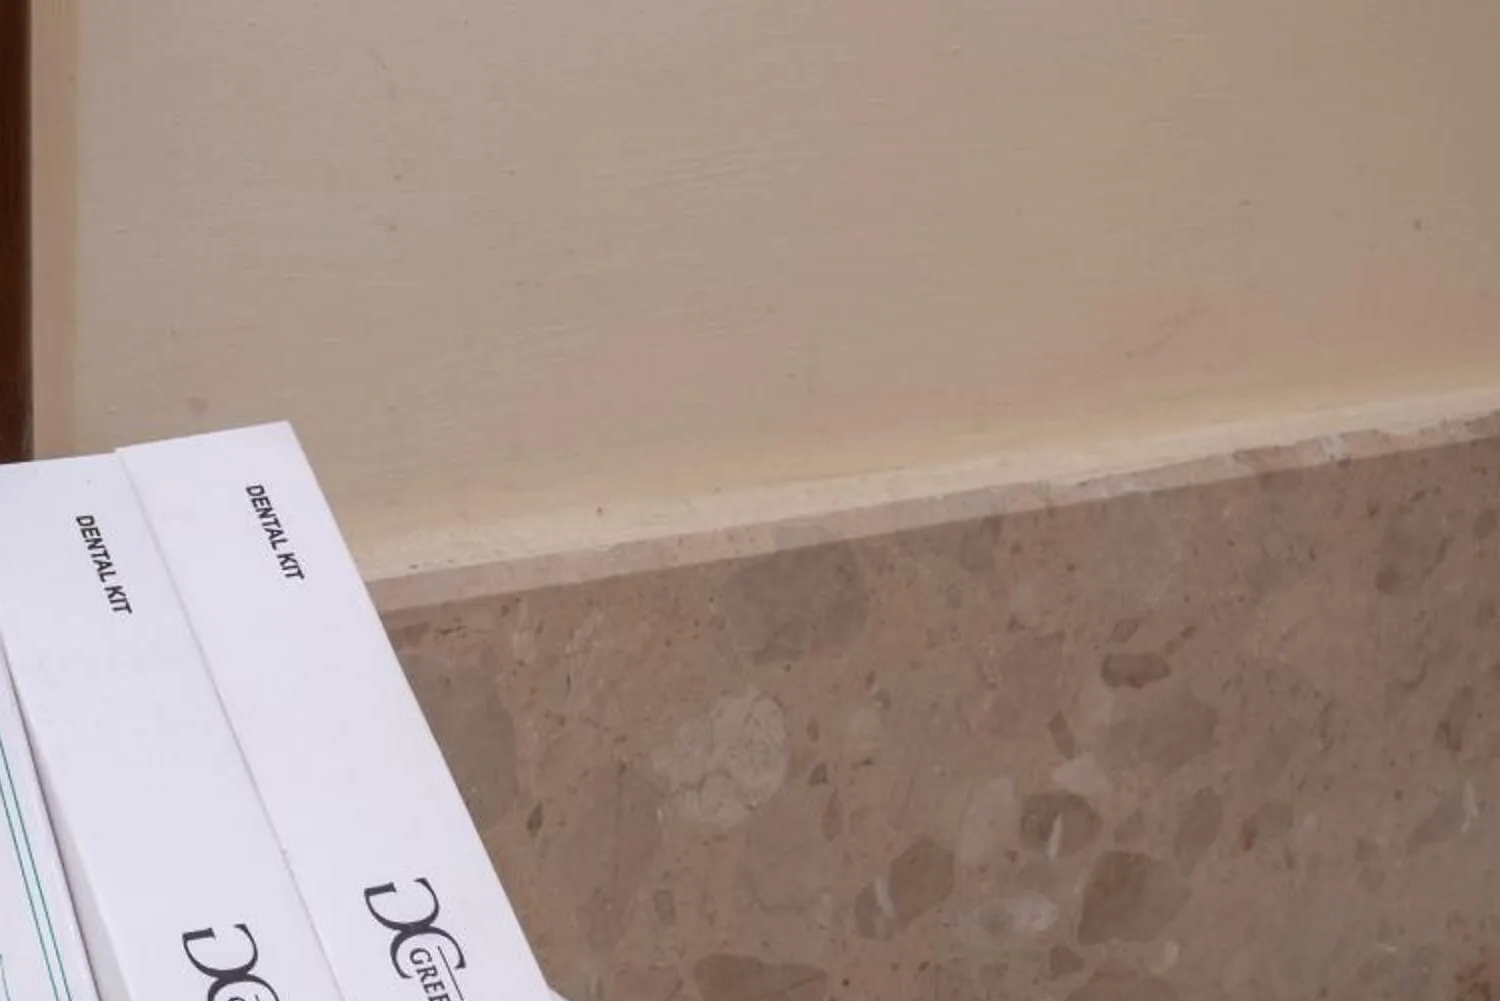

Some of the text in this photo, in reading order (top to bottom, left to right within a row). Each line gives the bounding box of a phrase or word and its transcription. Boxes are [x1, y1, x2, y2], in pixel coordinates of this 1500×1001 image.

[75, 514, 132, 615] DENTAL KIT
[246, 484, 305, 581] DENTAL KIT
